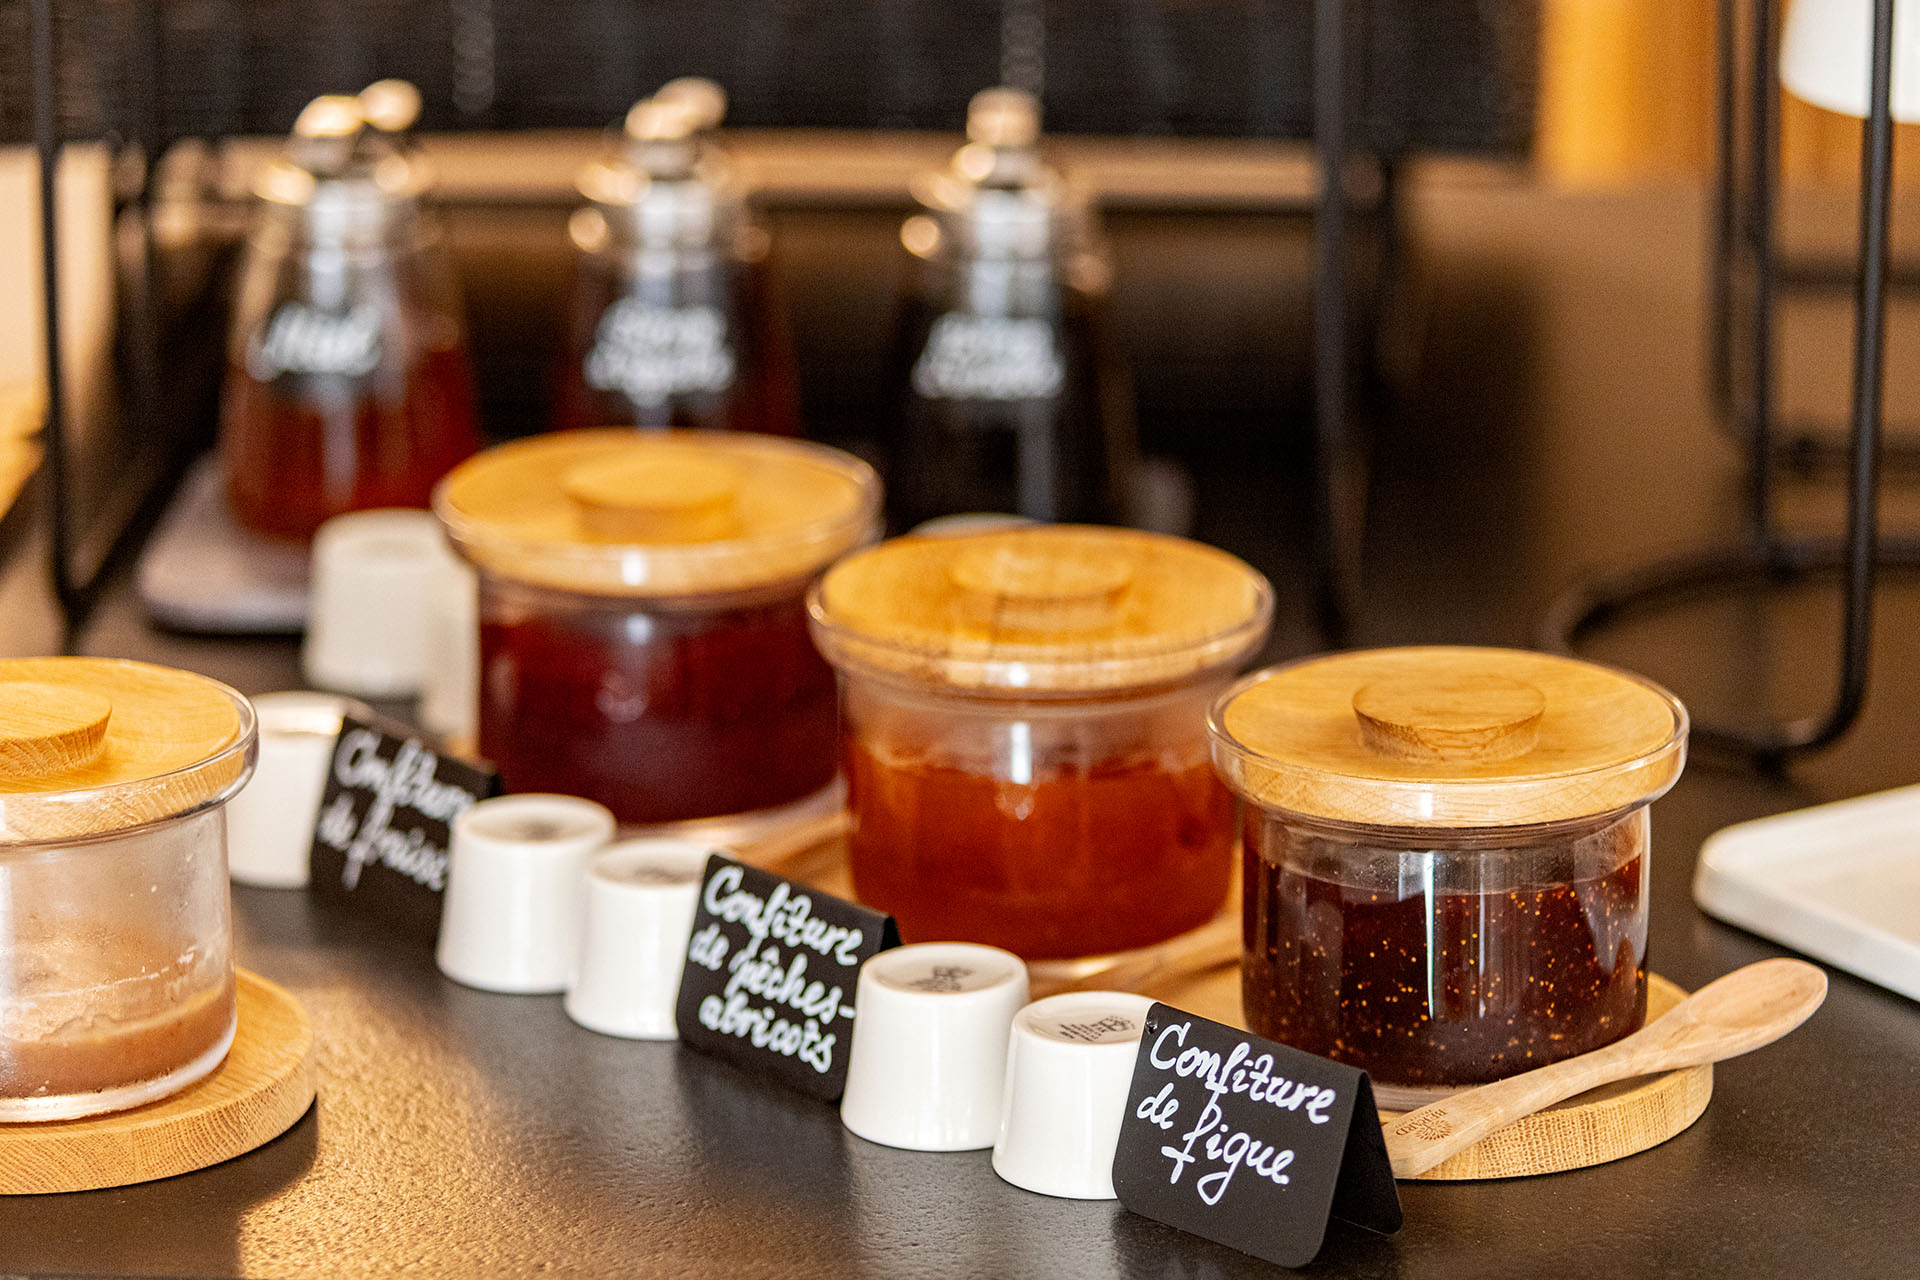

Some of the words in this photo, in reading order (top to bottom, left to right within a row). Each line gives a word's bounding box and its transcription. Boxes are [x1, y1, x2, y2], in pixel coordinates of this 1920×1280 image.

[688, 922, 730, 970] de
[704, 866, 863, 966] Confiture
[698, 990, 837, 1073] abricots
[1150, 1022, 1336, 1124] Confiture
[1136, 1082, 1179, 1129] de
[1161, 1101, 1294, 1206] figue
